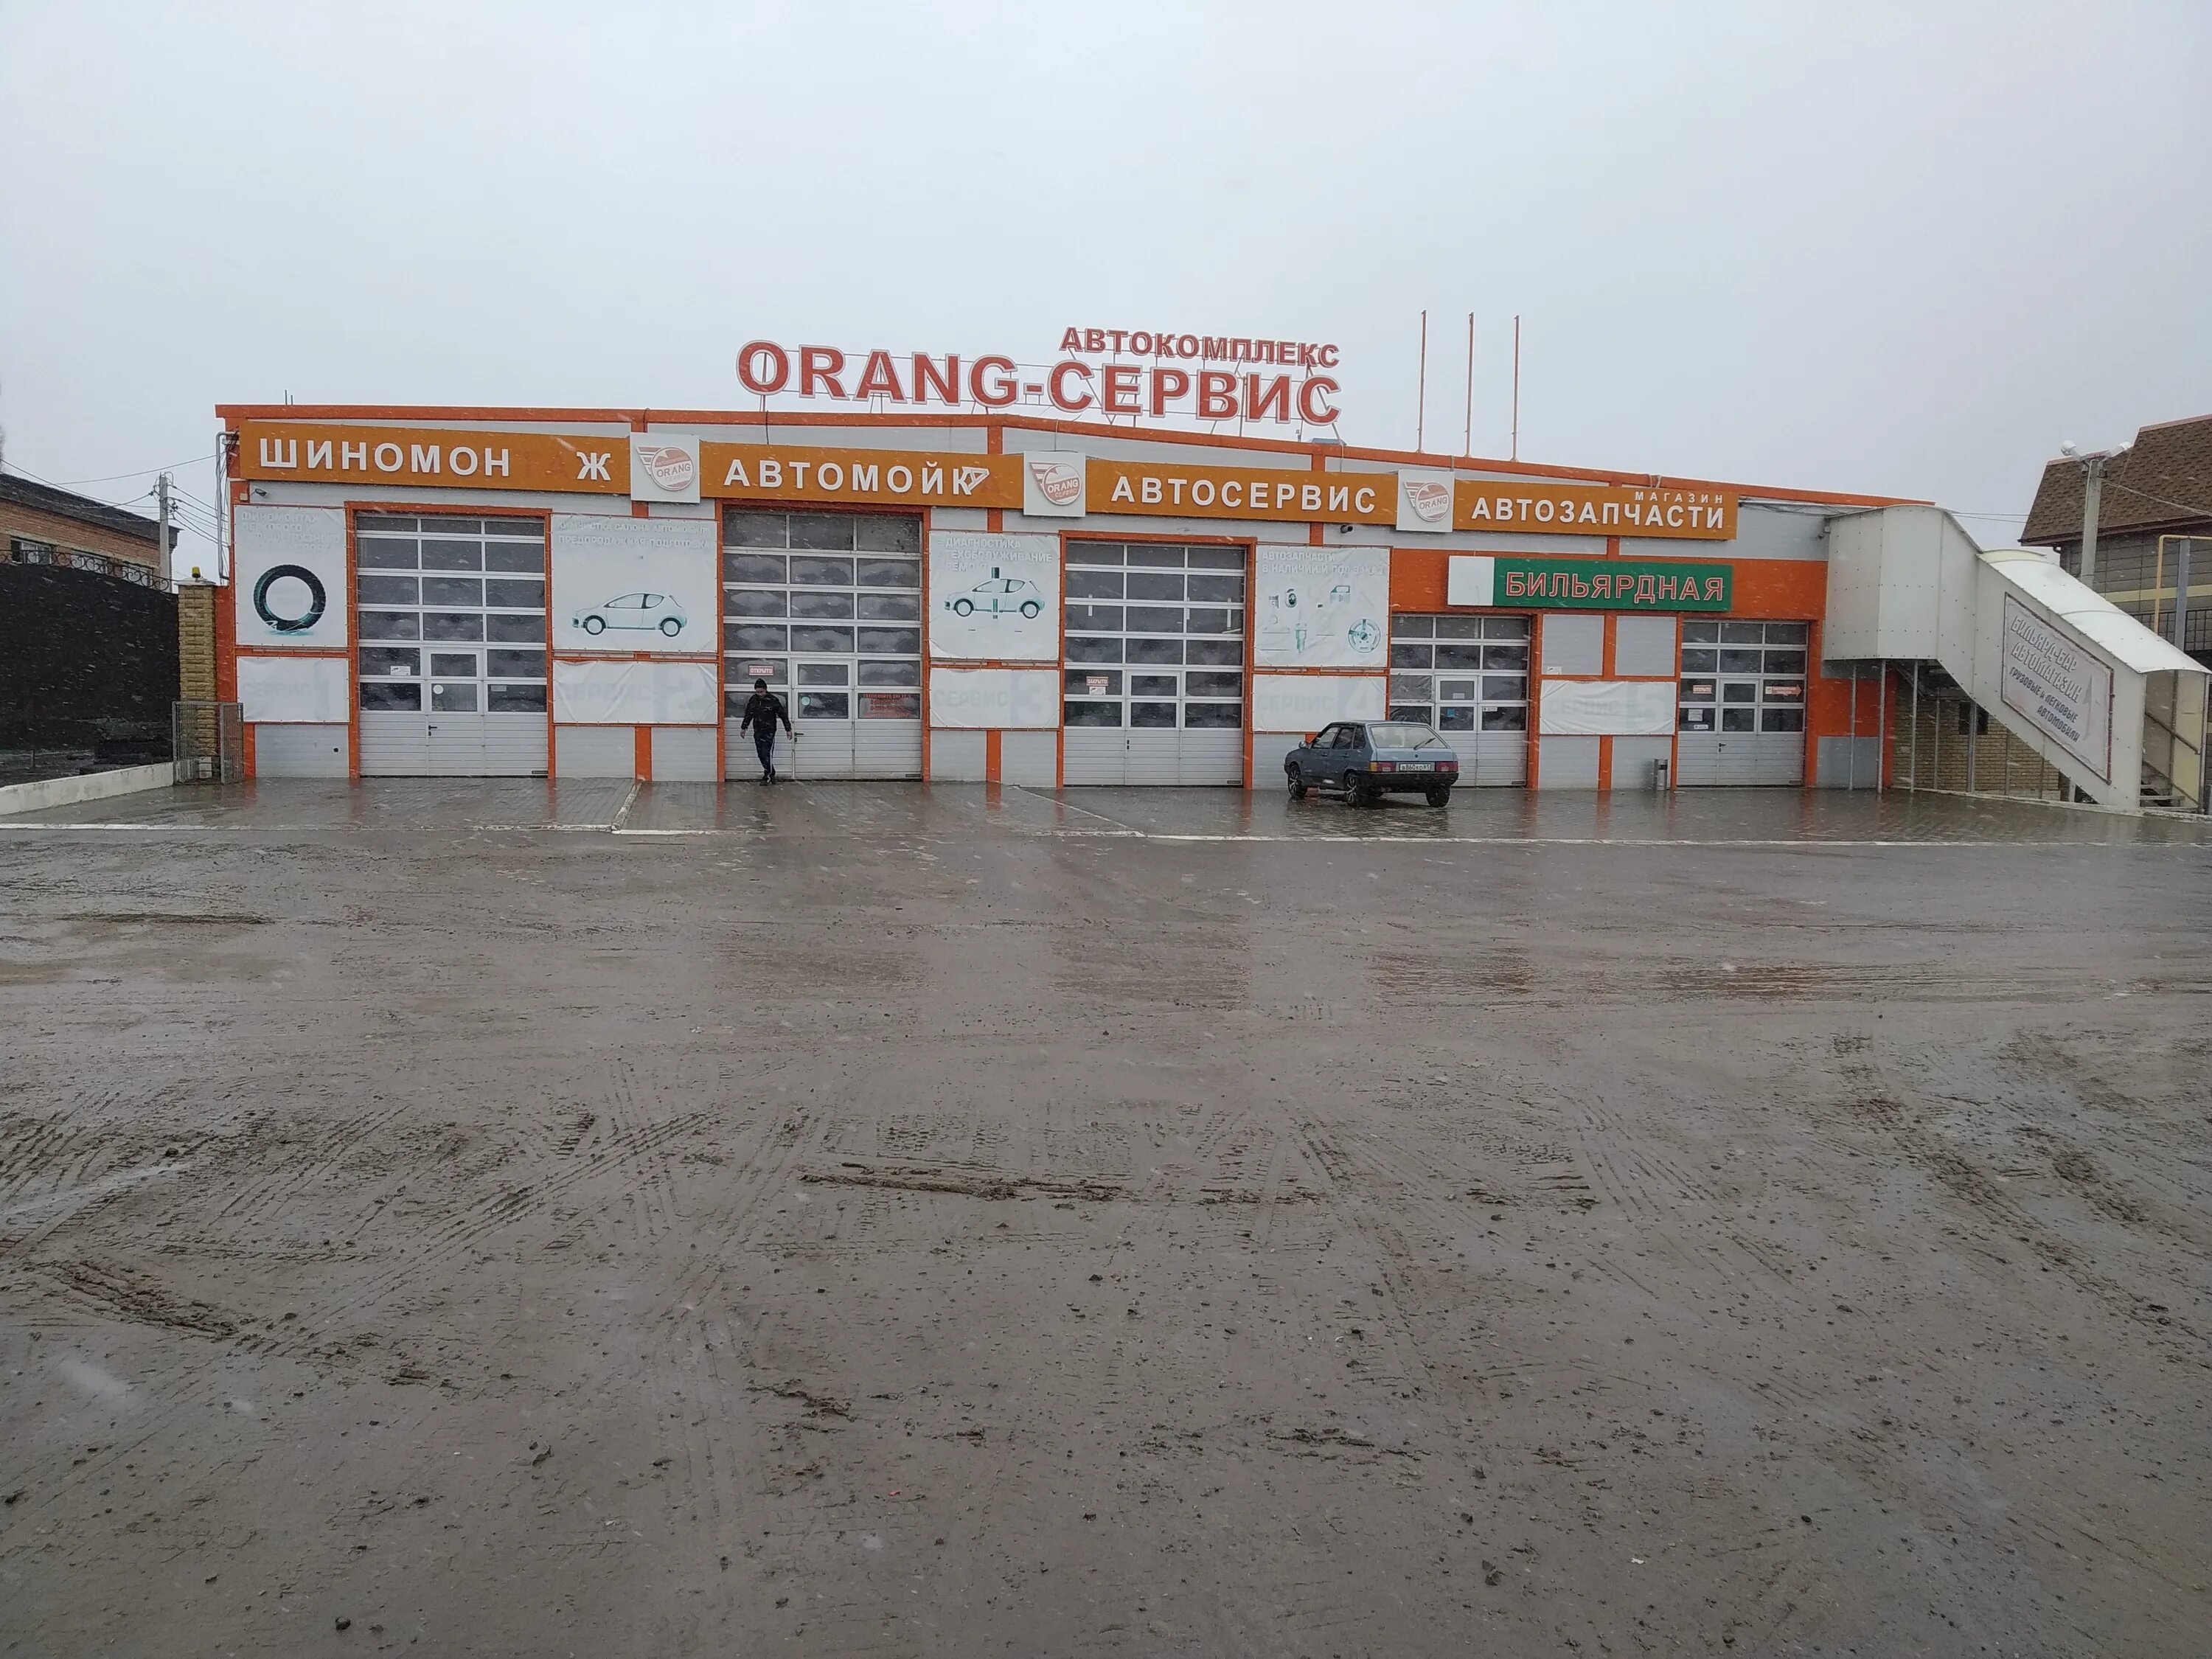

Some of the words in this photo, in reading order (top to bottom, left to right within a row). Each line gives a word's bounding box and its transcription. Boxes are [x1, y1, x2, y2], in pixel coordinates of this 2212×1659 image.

[1060, 326, 1340, 369] АВТОКОМПЛЕКС
[736, 339, 1343, 426] ORANG-СЕРВИС
[260, 438, 510, 477] ШИНОМОН
[577, 451, 612, 481] Ж
[657, 464, 691, 478] ORANG
[1047, 479, 1078, 493] ORANG
[1110, 476, 1376, 514] АВТОСЕРВИС
[1419, 497, 1447, 509] ORANG
[1635, 490, 1723, 504] МАГАЗИН
[1471, 496, 1723, 529] АВТОЗАПЧАСТИ
[945, 537, 1022, 549] ДИАГНОСТИКА
[1262, 551, 1336, 562] АВТОЗАПЧАСТИ
[1506, 571, 1724, 605] БИЛЬЯРДНАЯ
[2010, 614, 2078, 674] БИЛЬЯРД-БАР
[2011, 641, 2083, 704] АВТОМАГАЗИН
[2009, 666, 2042, 697] ГРУЗОВЫЕ
[2044, 694, 2079, 724] ЛЕГКОВЫЕ
[2037, 705, 2081, 743] АВТОМОБИЛИ
